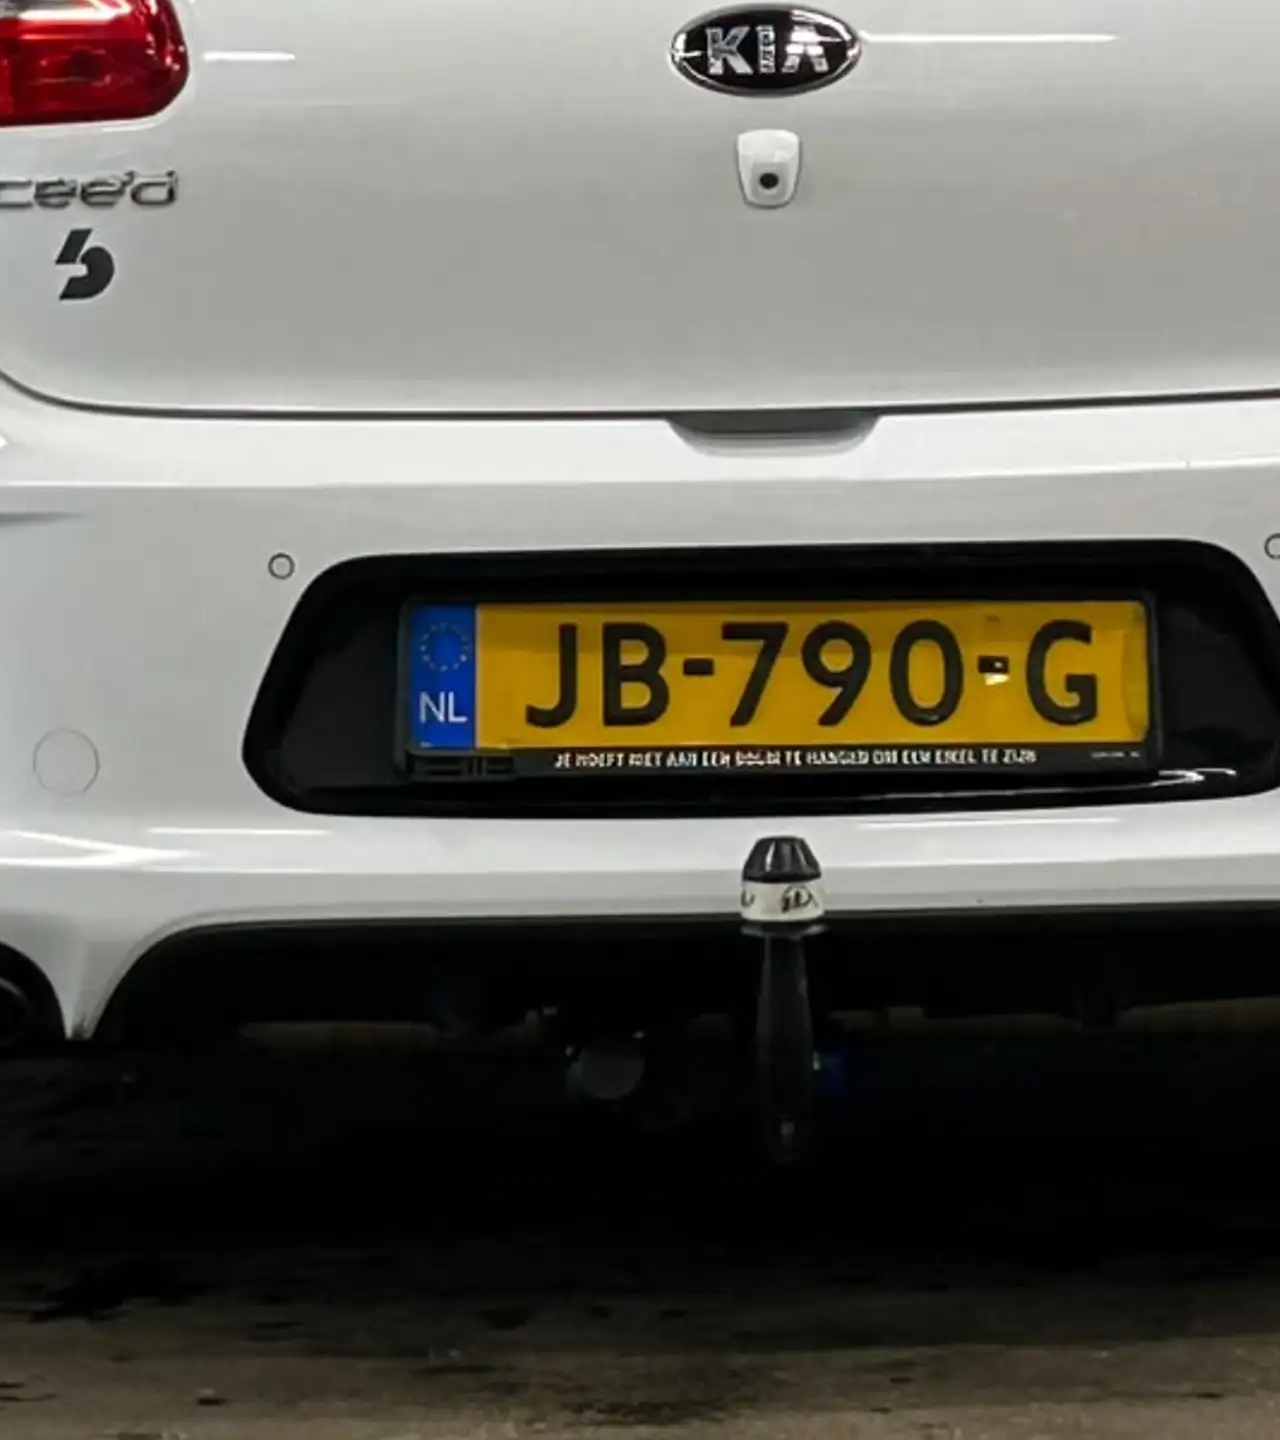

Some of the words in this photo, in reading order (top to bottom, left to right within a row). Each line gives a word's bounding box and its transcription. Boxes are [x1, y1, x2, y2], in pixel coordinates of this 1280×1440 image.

[705, 25, 830, 75] KIA
[419, 690, 469, 723] NL
[524, 619, 1100, 729] JB-790-G
